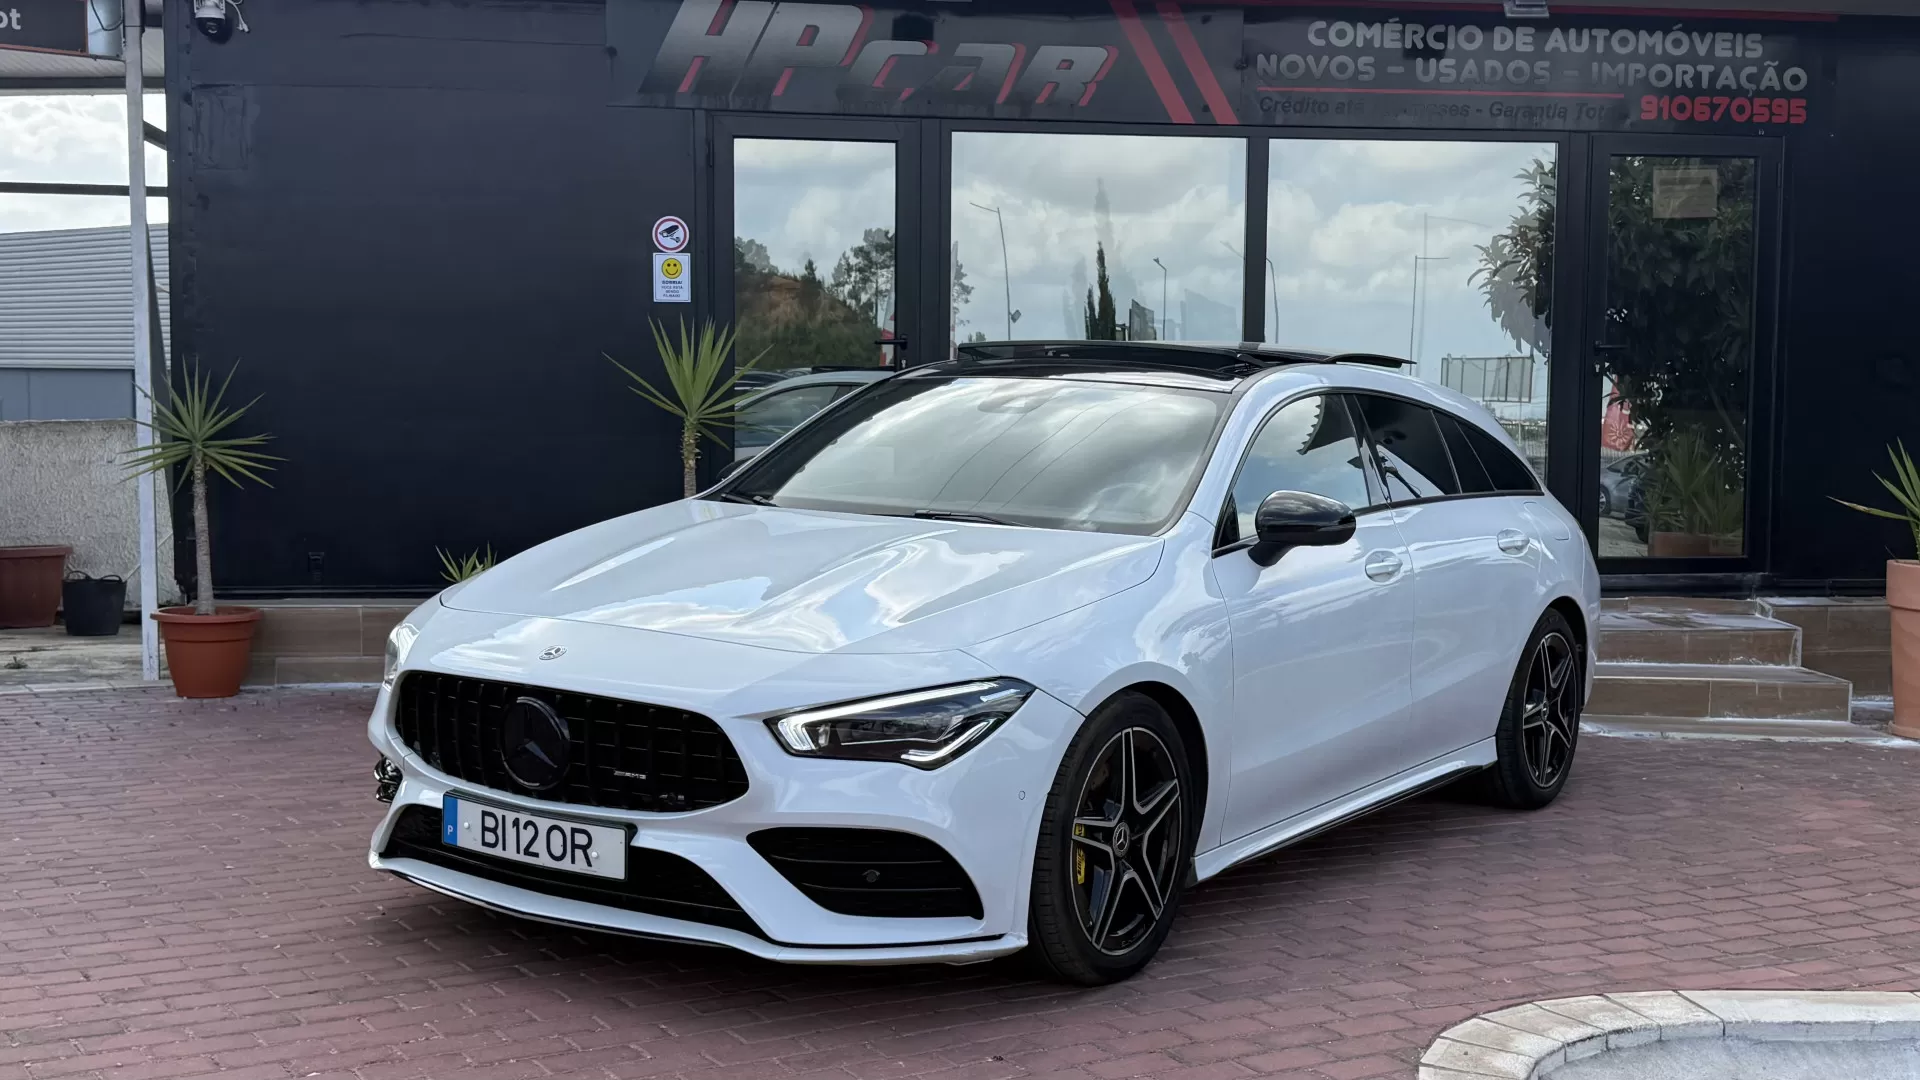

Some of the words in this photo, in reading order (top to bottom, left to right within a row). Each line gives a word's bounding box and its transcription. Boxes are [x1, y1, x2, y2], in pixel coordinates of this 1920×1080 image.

[1307, 17, 1484, 51] COMÉRCIO
[1493, 25, 1536, 52] DE
[1544, 23, 1764, 58] AUTOMÓVEIS
[1256, 53, 1376, 81] NOVOS
[1415, 57, 1550, 84] USADOS
[1591, 60, 1808, 97] IMPORTAÇÃO
[1259, 96, 1330, 114] Crédito
[1640, 95, 1807, 124] 910670595
[447, 824, 454, 836] P
